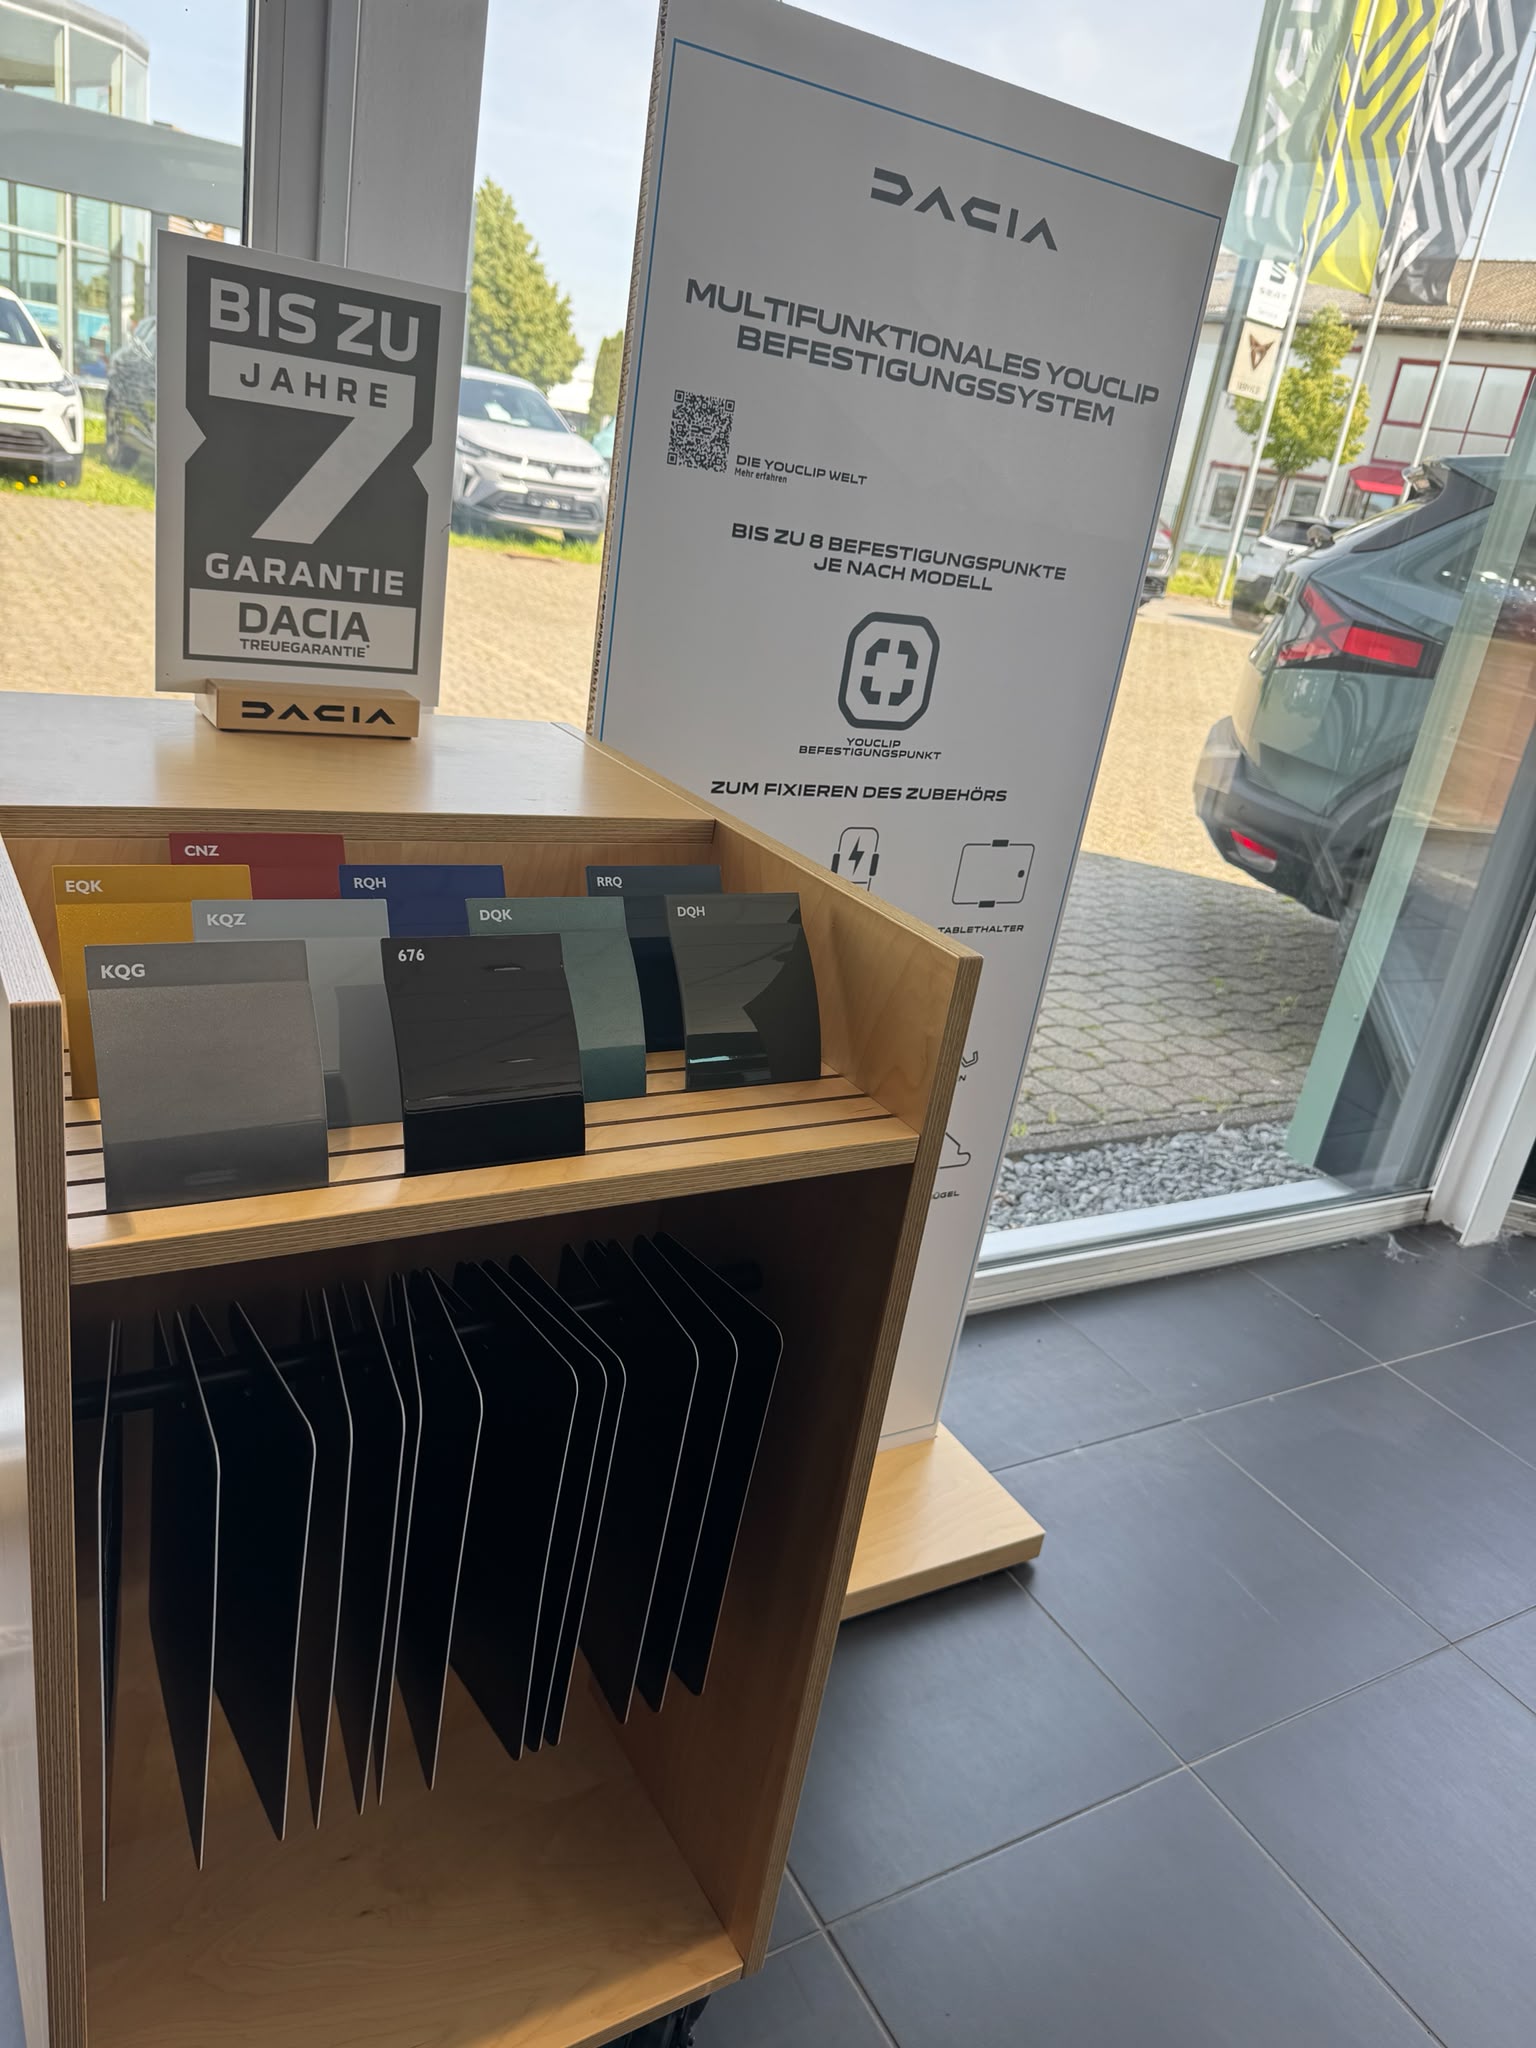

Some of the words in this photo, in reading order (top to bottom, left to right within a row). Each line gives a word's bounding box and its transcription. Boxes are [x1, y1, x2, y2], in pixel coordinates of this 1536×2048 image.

[870, 167, 1057, 251] DACIA
[210, 278, 316, 344] BIS
[337, 303, 419, 362] ZU
[685, 278, 1053, 380] MULTIFUNKTIONALES
[1046, 362, 1159, 405] YOUCLIP
[737, 325, 1115, 426] BEFESTIGUNGSSYSTEM
[240, 363, 388, 408] JAHRE
[209, 341, 415, 544] 7
[734, 467, 754, 479] Mehr
[755, 471, 787, 483] erfahren
[736, 455, 761, 468] DIE
[764, 459, 826, 478] YOUCLIP
[829, 470, 867, 485] WELT
[732, 523, 769, 541] BIS
[774, 529, 805, 546] ZU
[809, 534, 823, 548] 8
[828, 536, 1067, 581] BEFESTIGUNGSPUNKTE
[205, 552, 404, 595] GARANTIE
[813, 557, 842, 573] JE
[846, 560, 905, 581] NACH
[910, 567, 993, 591] MODELL
[239, 602, 370, 643] DACIA
[242, 701, 395, 725] DACIA
[846, 738, 901, 748] YOUCLIP
[799, 746, 941, 760] BEFESTIGUNGSPUNKT
[711, 781, 759, 796] ZUM
[764, 783, 858, 799] FIXIEREN
[862, 786, 902, 800] DES
[906, 786, 1007, 802] ZUBEHÖRS
[184, 845, 220, 857] CNZ
[65, 880, 103, 895] EQK
[354, 877, 387, 890] RQH
[596, 876, 622, 889] RRQ
[206, 913, 247, 928] KQZ
[479, 909, 512, 923] DQK
[677, 906, 706, 918] DQH
[938, 925, 1024, 934] TABLETHALTER
[398, 949, 425, 962] 676
[101, 963, 146, 981] KQG
